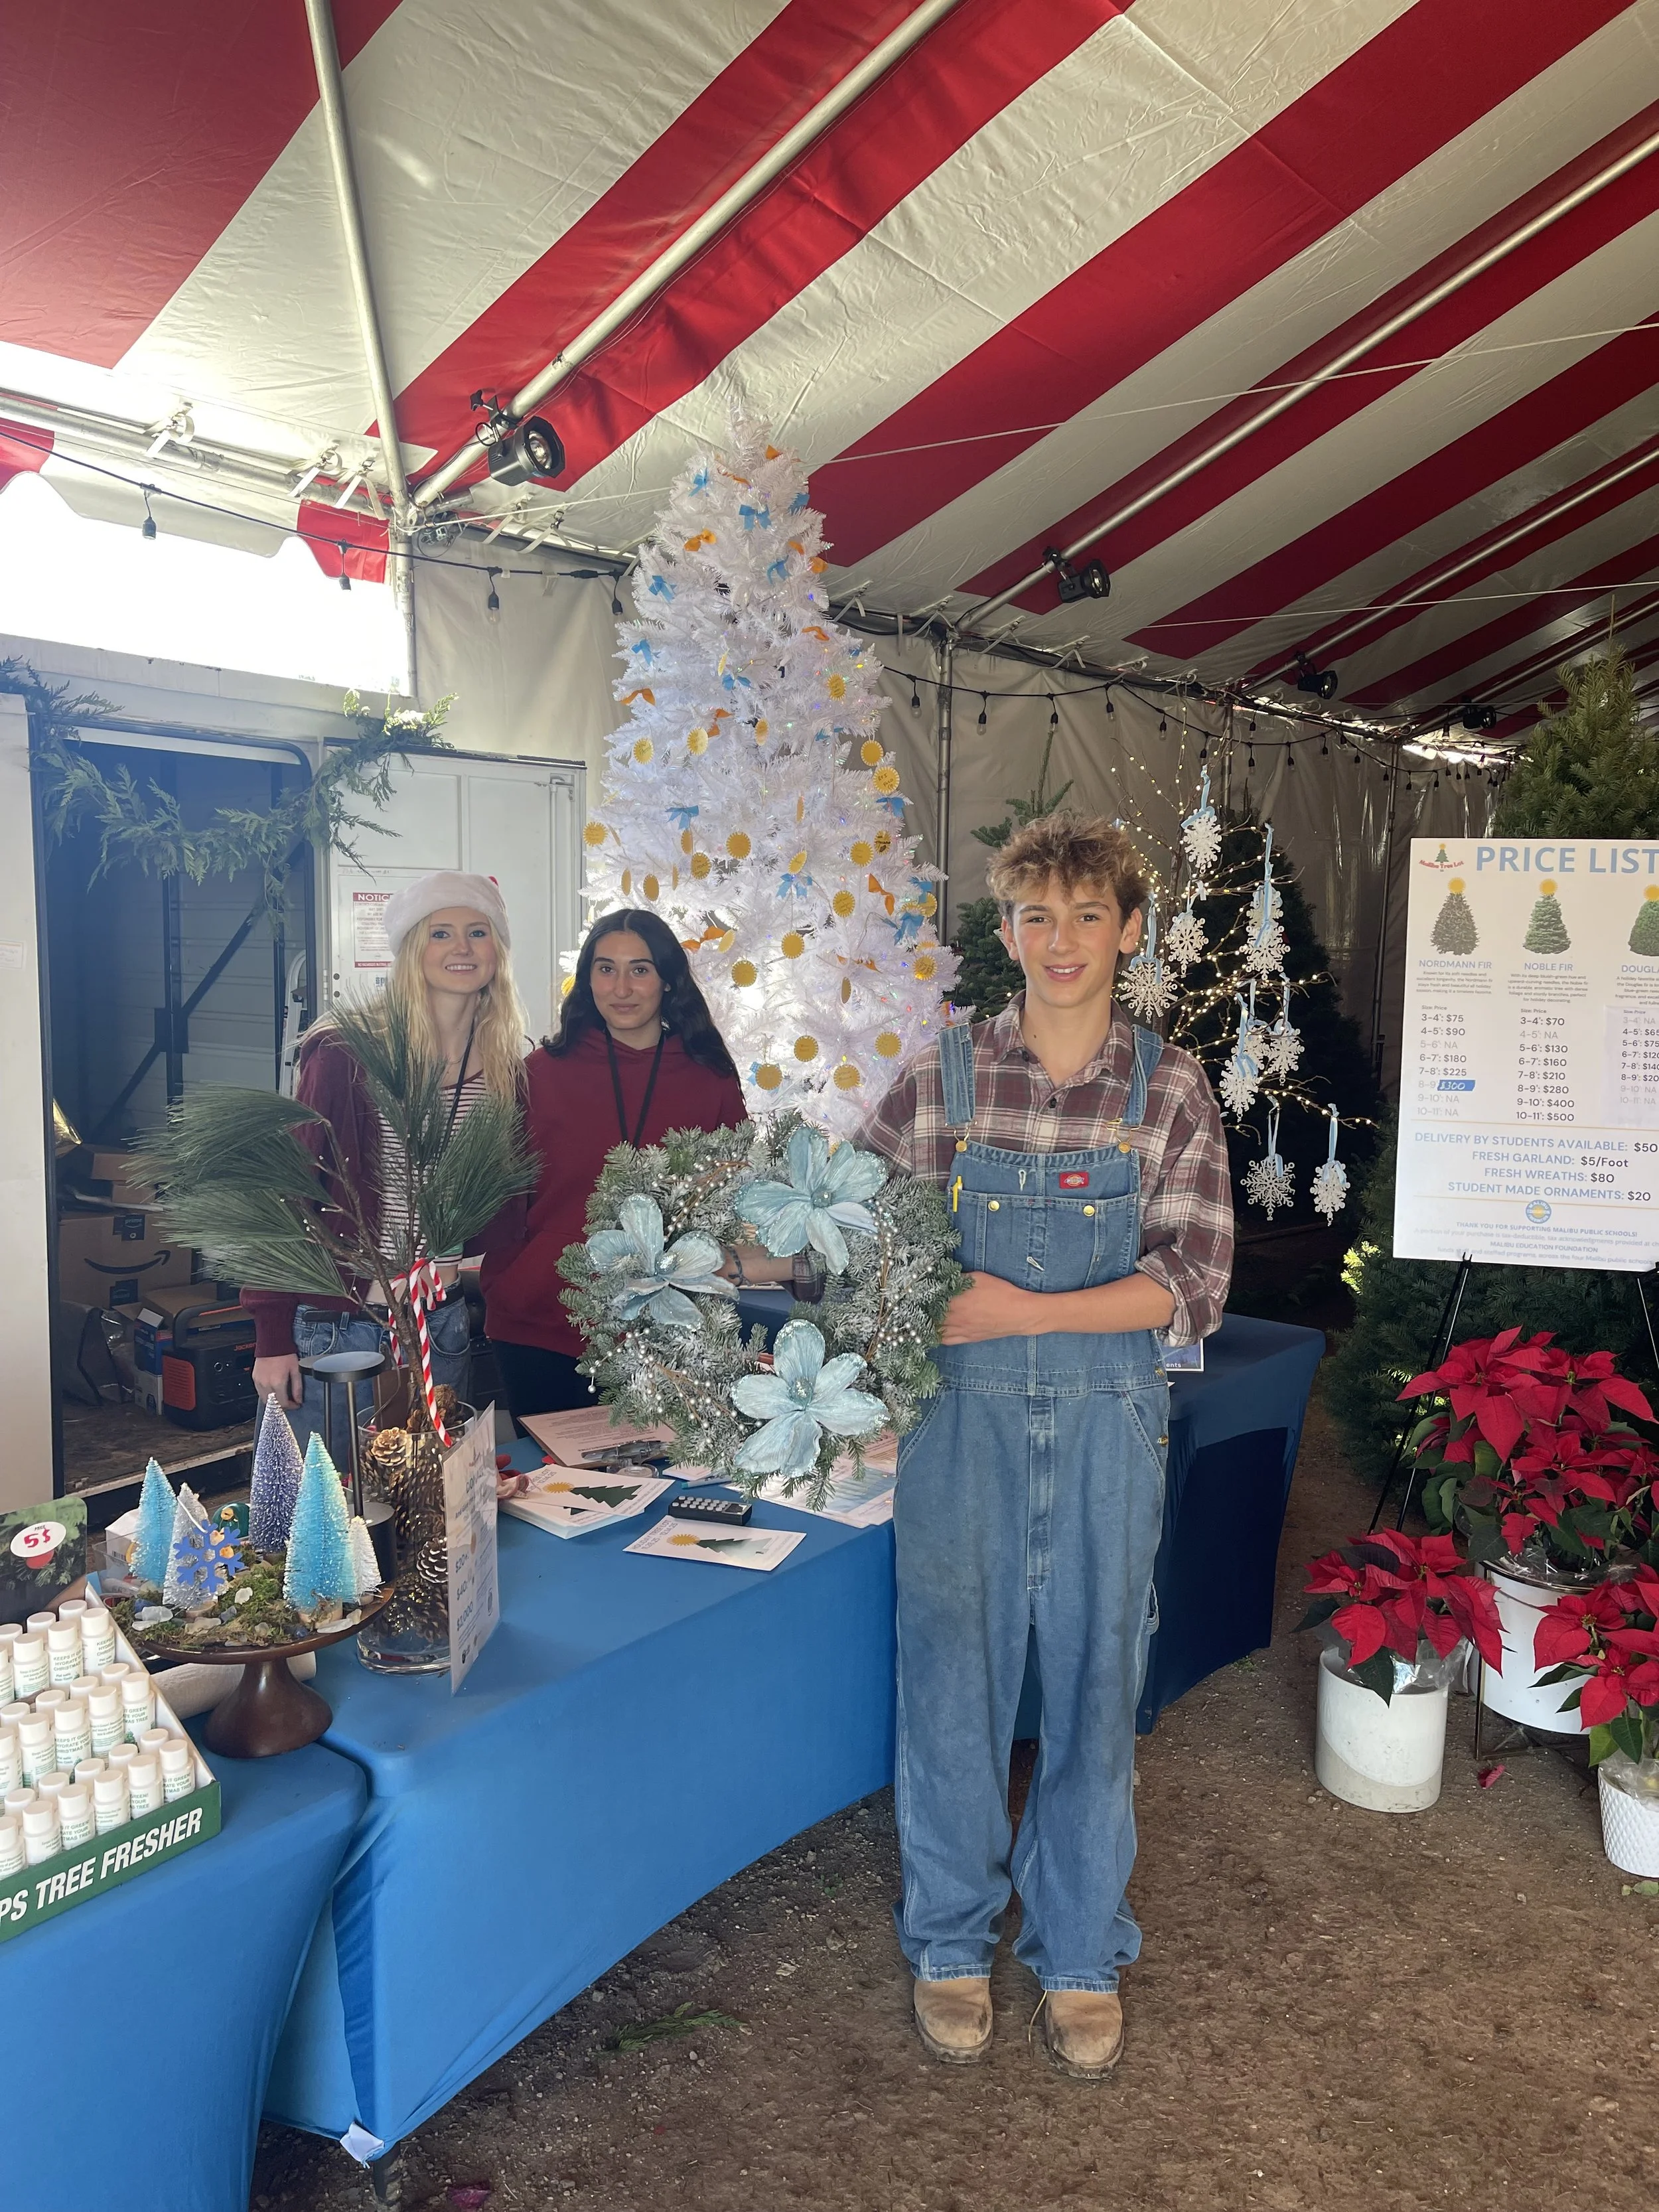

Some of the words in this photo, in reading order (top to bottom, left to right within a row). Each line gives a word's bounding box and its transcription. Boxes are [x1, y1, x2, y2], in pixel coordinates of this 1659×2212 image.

[1476, 846, 1575, 873] PRICE
[1589, 848, 1659, 873] LIST
[1419, 960, 1475, 968] NORDMANN
[1546, 1017, 1565, 1026] $70
[1445, 1027, 1465, 1036] $90
[1545, 1045, 1568, 1053] $130
[1543, 1058, 1567, 1067] $160
[1443, 1068, 1467, 1076] $225
[1542, 1071, 1565, 1080] $210
[1440, 1081, 1466, 1090] $300
[1543, 1085, 1569, 1094] $280
[1547, 1099, 1575, 1108] $400
[1547, 1112, 1574, 1122] $500
[1415, 1132, 1471, 1144] DELIVERY
[1474, 1135, 1489, 1145] BY
[1492, 1136, 1554, 1147] STUDENTS
[1557, 1139, 1628, 1151] AVAILABLE:
[1634, 1142, 1658, 1153] $50
[1473, 1151, 1509, 1161] FRESH
[1512, 1153, 1574, 1165] GARLAND:
[1581, 1155, 1628, 1167] $5/Foot
[1484, 1167, 1522, 1178] FRESH
[1525, 1170, 1587, 1182] WREATHS:
[1591, 1173, 1615, 1183] $80
[1448, 1182, 1502, 1193] STUDENT
[1505, 1185, 1540, 1195] MADE
[1544, 1187, 1624, 1200] ORNAMENTS:
[1628, 1191, 1651, 1201] $20
[181, 1783, 192, 1791] TREE
[74, 1826, 88, 1834] YOUR
[35, 1856, 97, 1910] TREE
[100, 1807, 204, 1880] FRESHER
